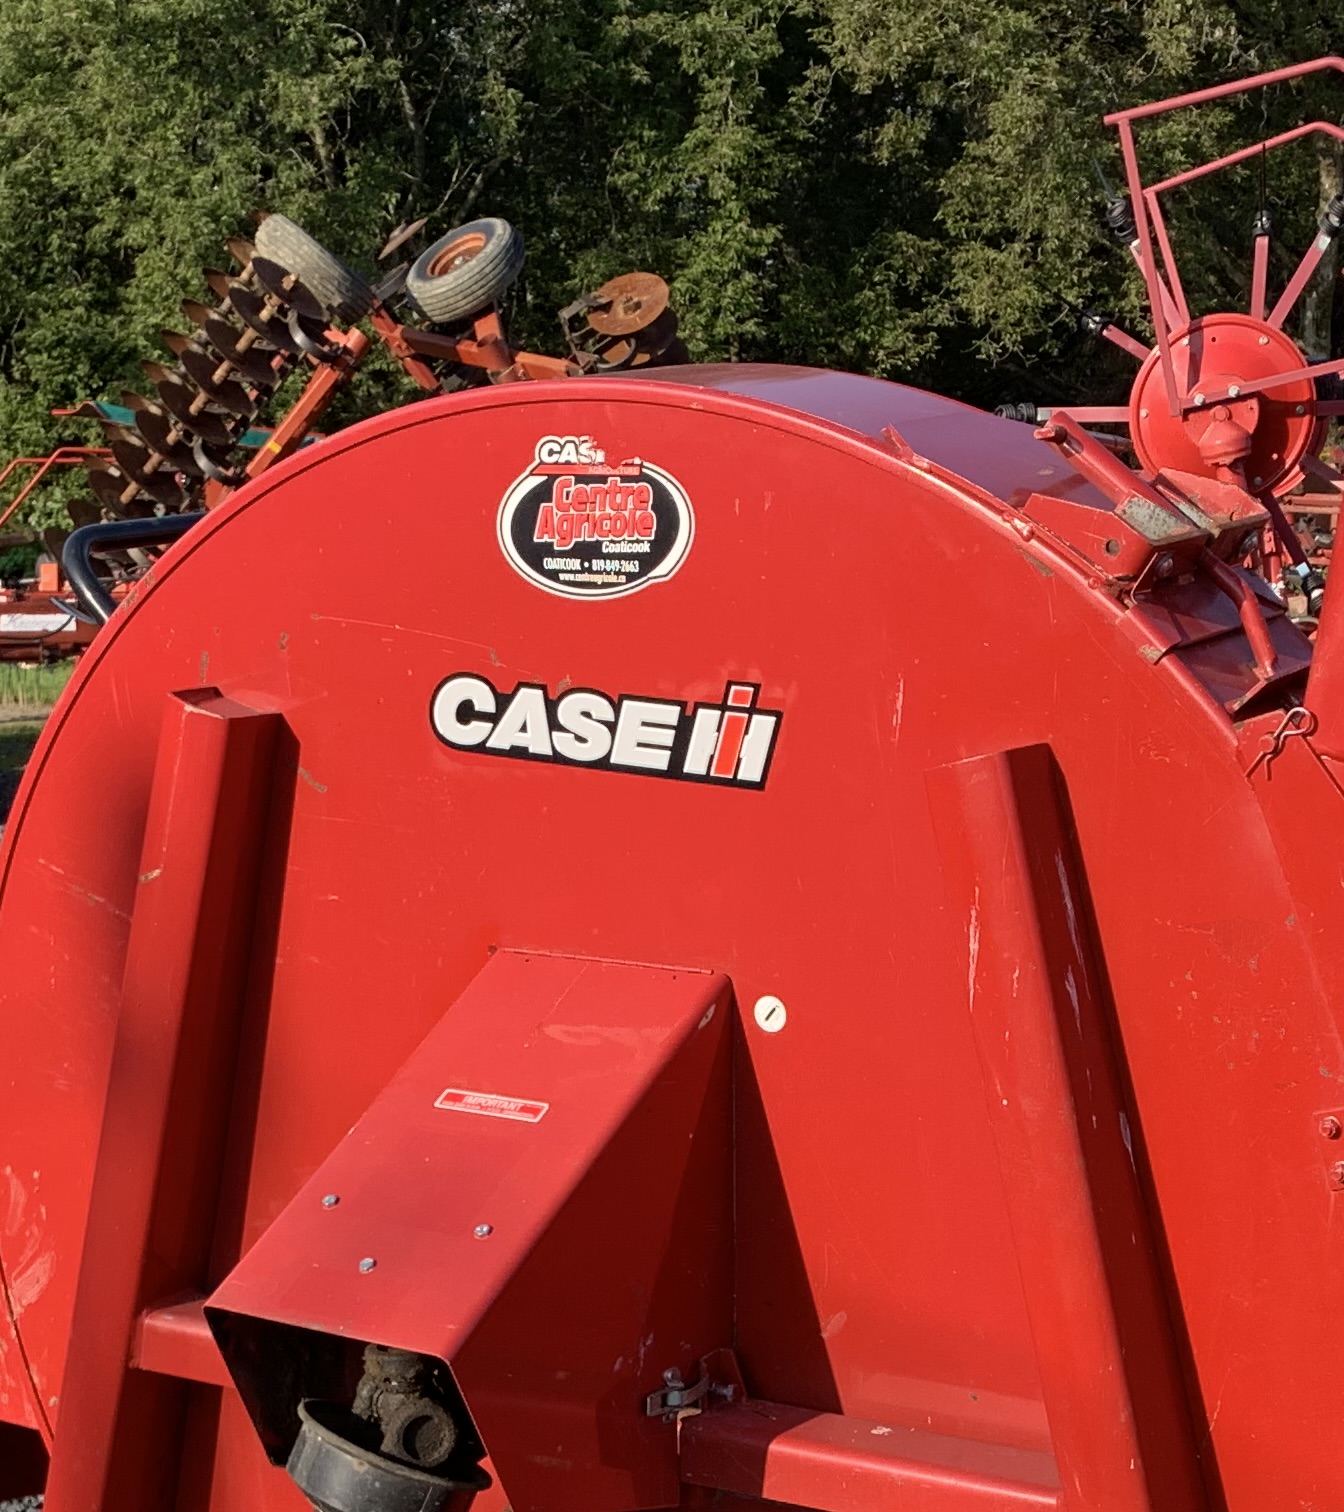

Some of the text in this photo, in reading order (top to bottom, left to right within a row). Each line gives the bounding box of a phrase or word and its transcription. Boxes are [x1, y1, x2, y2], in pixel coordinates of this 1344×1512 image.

[553, 478, 652, 513] Centre
[535, 504, 656, 549] Agricole
[602, 541, 650, 553] Coaticook
[543, 557, 581, 571] COATICOOK
[432, 676, 682, 771] CASE
[462, 1096, 524, 1111] IMPORTANT
